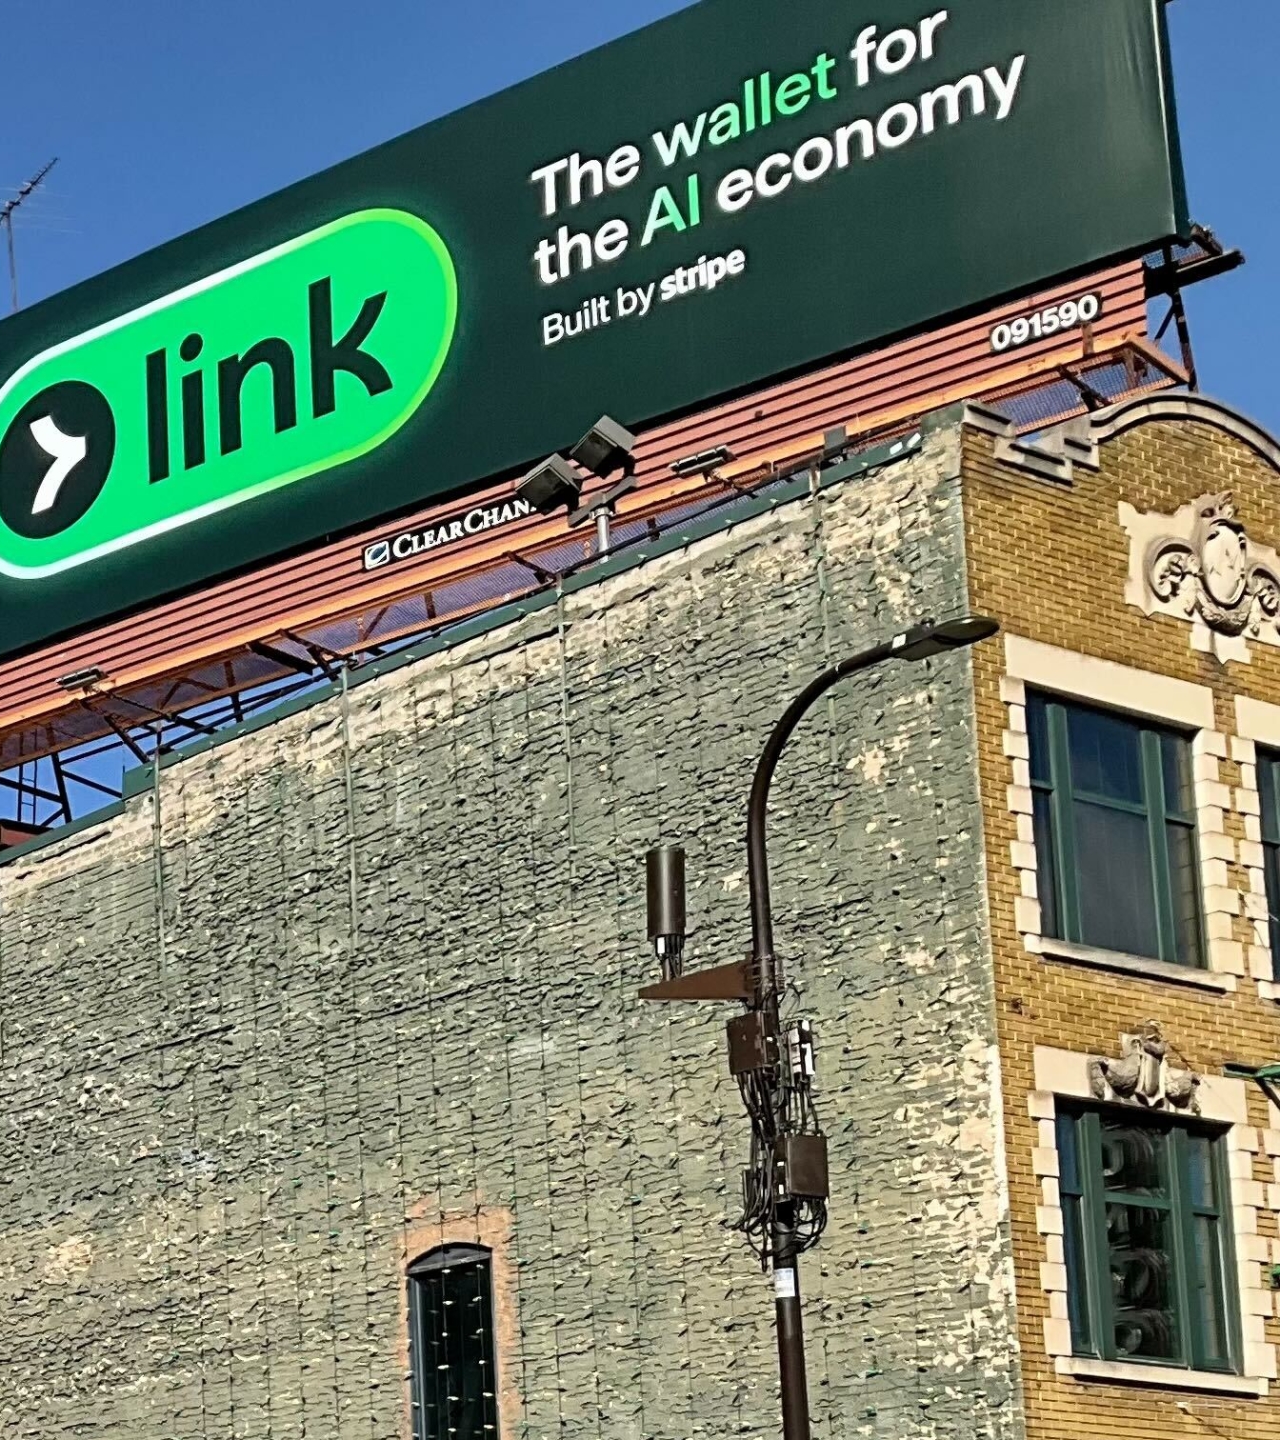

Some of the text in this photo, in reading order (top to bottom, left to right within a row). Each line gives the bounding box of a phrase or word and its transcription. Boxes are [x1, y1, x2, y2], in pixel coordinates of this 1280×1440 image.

[531, 9, 948, 216] The wallet for
[533, 54, 1026, 286] the AI economy
[542, 248, 746, 346] Built by stripe
[991, 294, 1098, 351] 091590
[146, 275, 394, 486] link
[392, 497, 538, 559] CLEARCHAN
